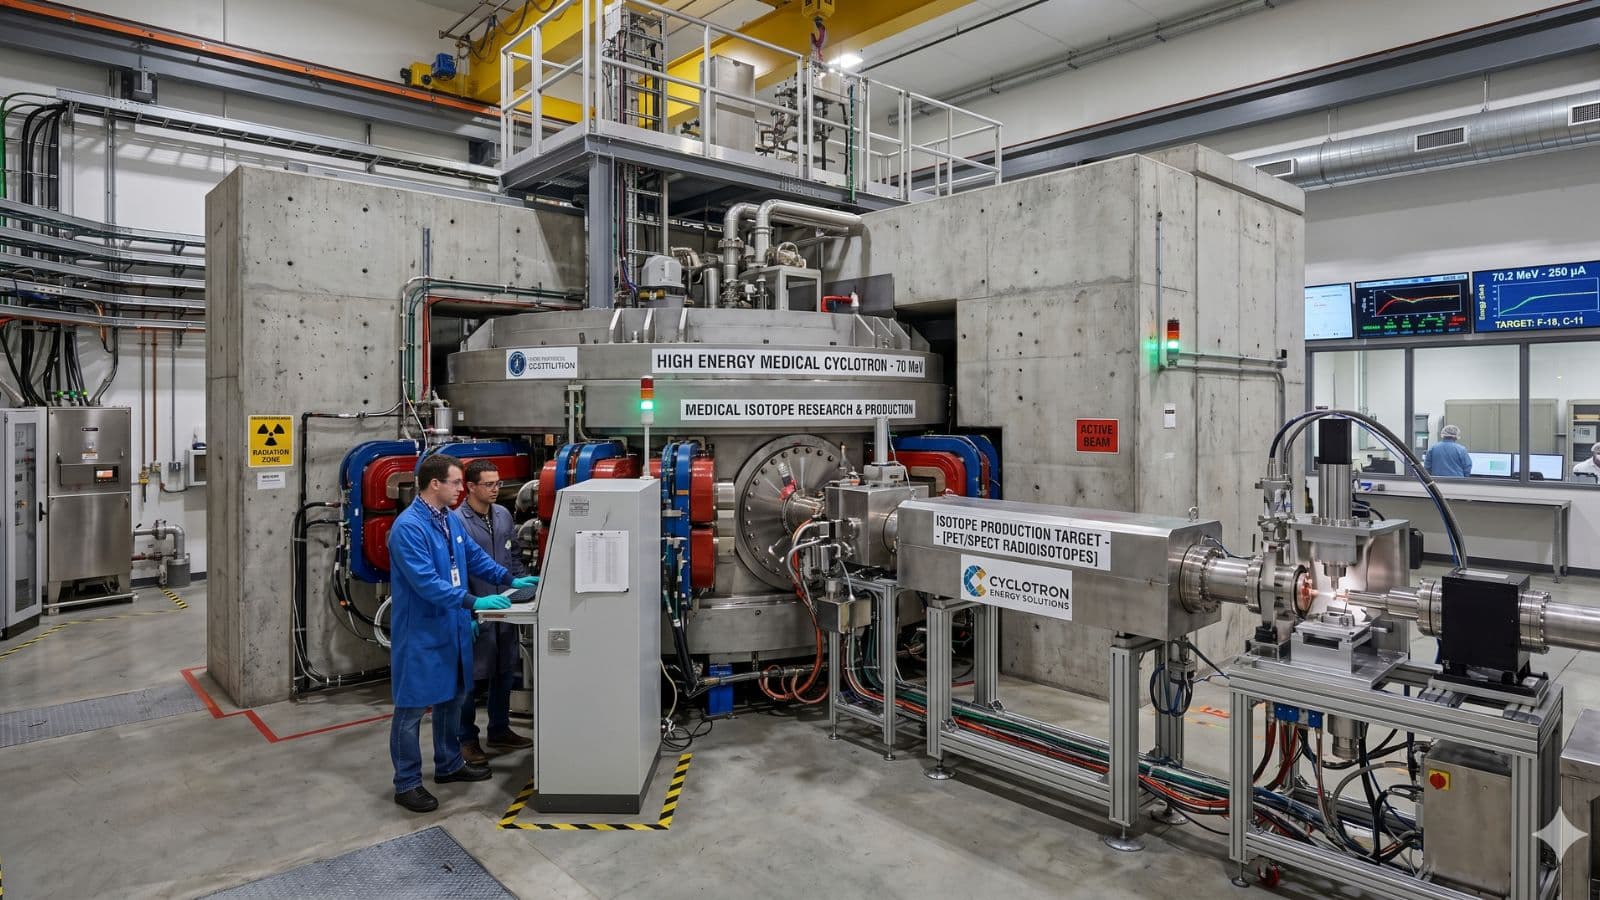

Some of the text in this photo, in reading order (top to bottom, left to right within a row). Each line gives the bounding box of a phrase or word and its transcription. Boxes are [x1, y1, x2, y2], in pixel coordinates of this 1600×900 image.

[1492, 272, 1514, 282] 70.2
[1516, 270, 1539, 280] MeV
[1548, 267, 1568, 278] 250
[1495, 320, 1534, 328] TARGET:
[1562, 317, 1584, 325] C-11
[657, 354, 693, 369] HIGH
[698, 354, 756, 369] ENERGY
[760, 354, 820, 370] MEDICAL
[824, 356, 888, 372] CYCLOTRON
[896, 360, 906, 373] 70
[908, 360, 923, 374] MeV
[685, 403, 914, 416] MEDICAL ISOTOPE RESEARCH & PRODUCTION
[1081, 424, 1113, 434] ACTIVE
[1083, 437, 1110, 447] BEAM
[936, 515, 978, 531] ISOTOPE
[980, 520, 1050, 540] PRODUCTION
[1054, 529, 1102, 547] TARGET
[943, 531, 1000, 550] [PET/SPECT
[1003, 542, 1098, 566] RADIOISOTOPES]
[990, 576, 1069, 600] CYCLOTRON
[990, 589, 1070, 610] ENERGY SOLUTIONS
